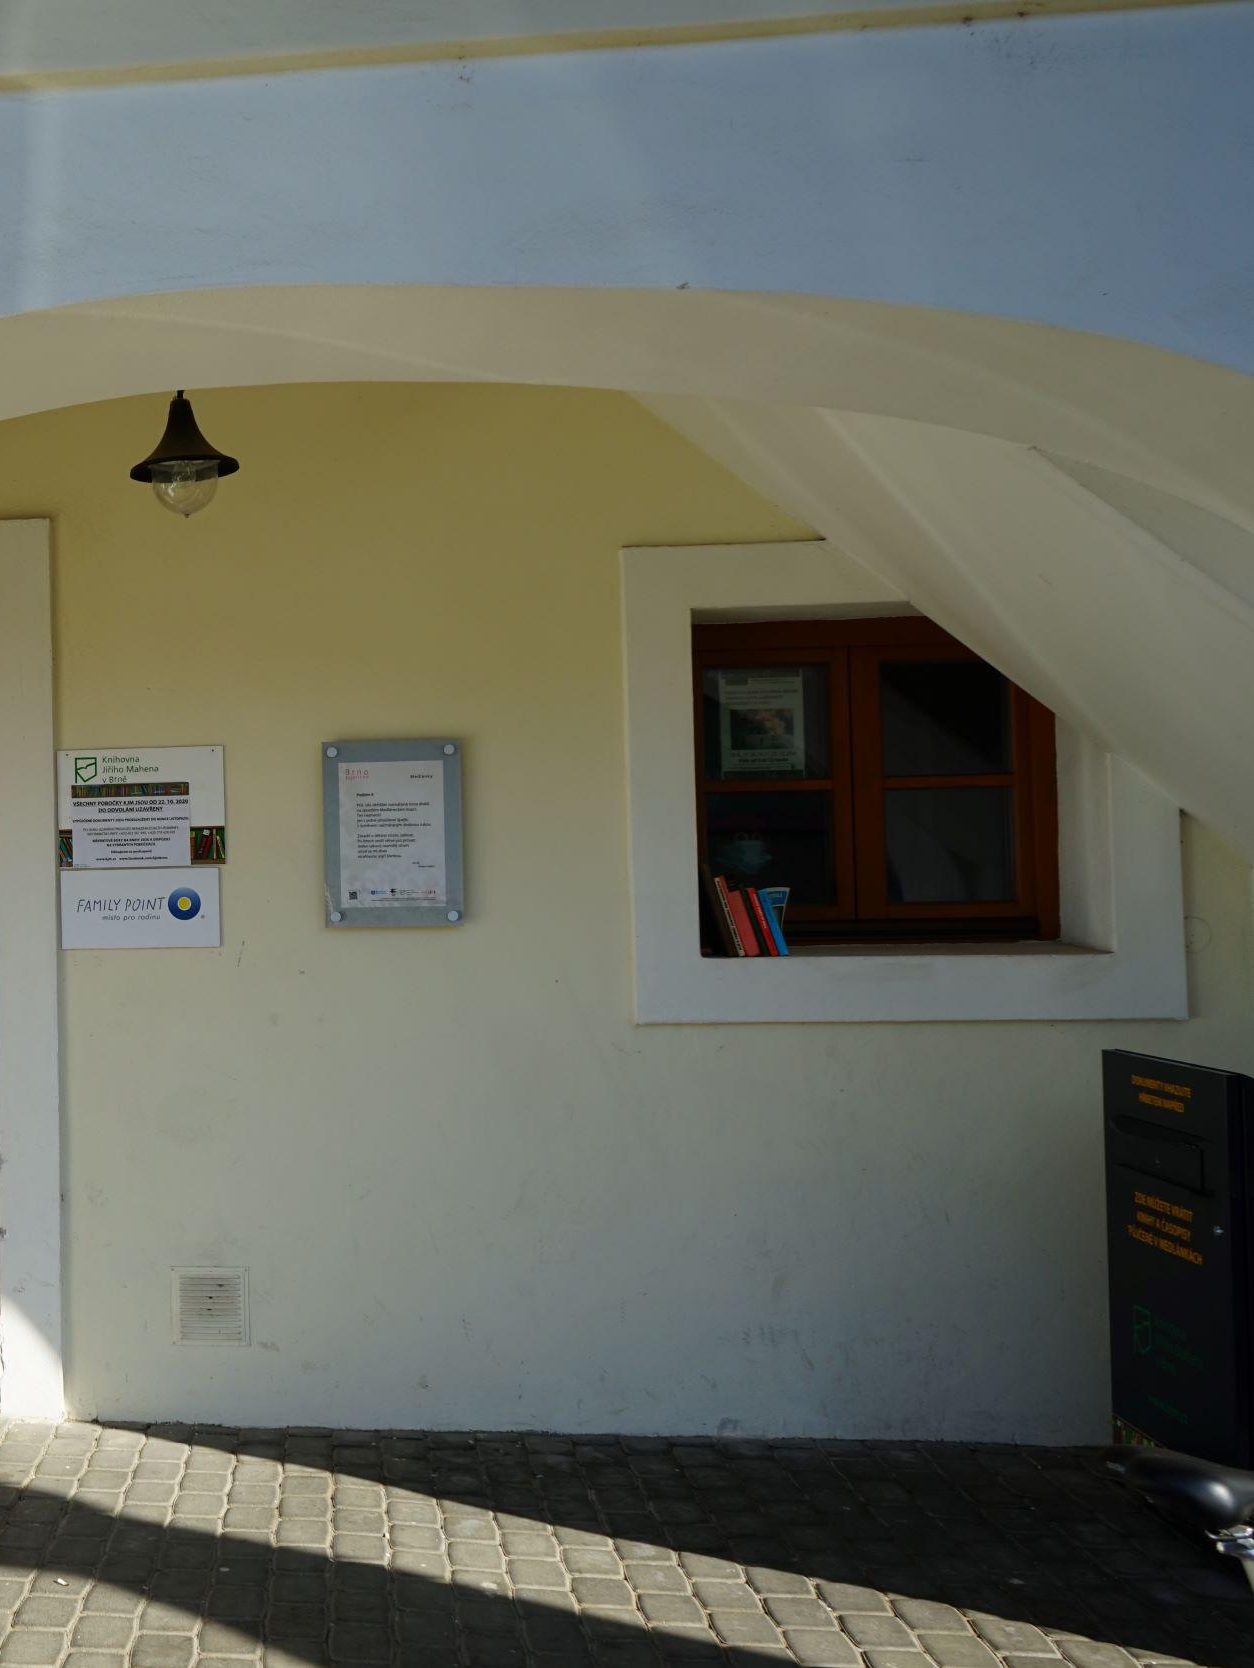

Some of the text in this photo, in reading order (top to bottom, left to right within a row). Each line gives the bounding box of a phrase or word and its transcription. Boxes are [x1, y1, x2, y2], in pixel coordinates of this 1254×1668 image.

[102, 756, 140, 764] Knihovna
[102, 765, 159, 774] Jiřího Mahena
[77, 896, 166, 913] FAMILY POINT
[123, 914, 136, 922] pro
[137, 912, 161, 921] rodinu
